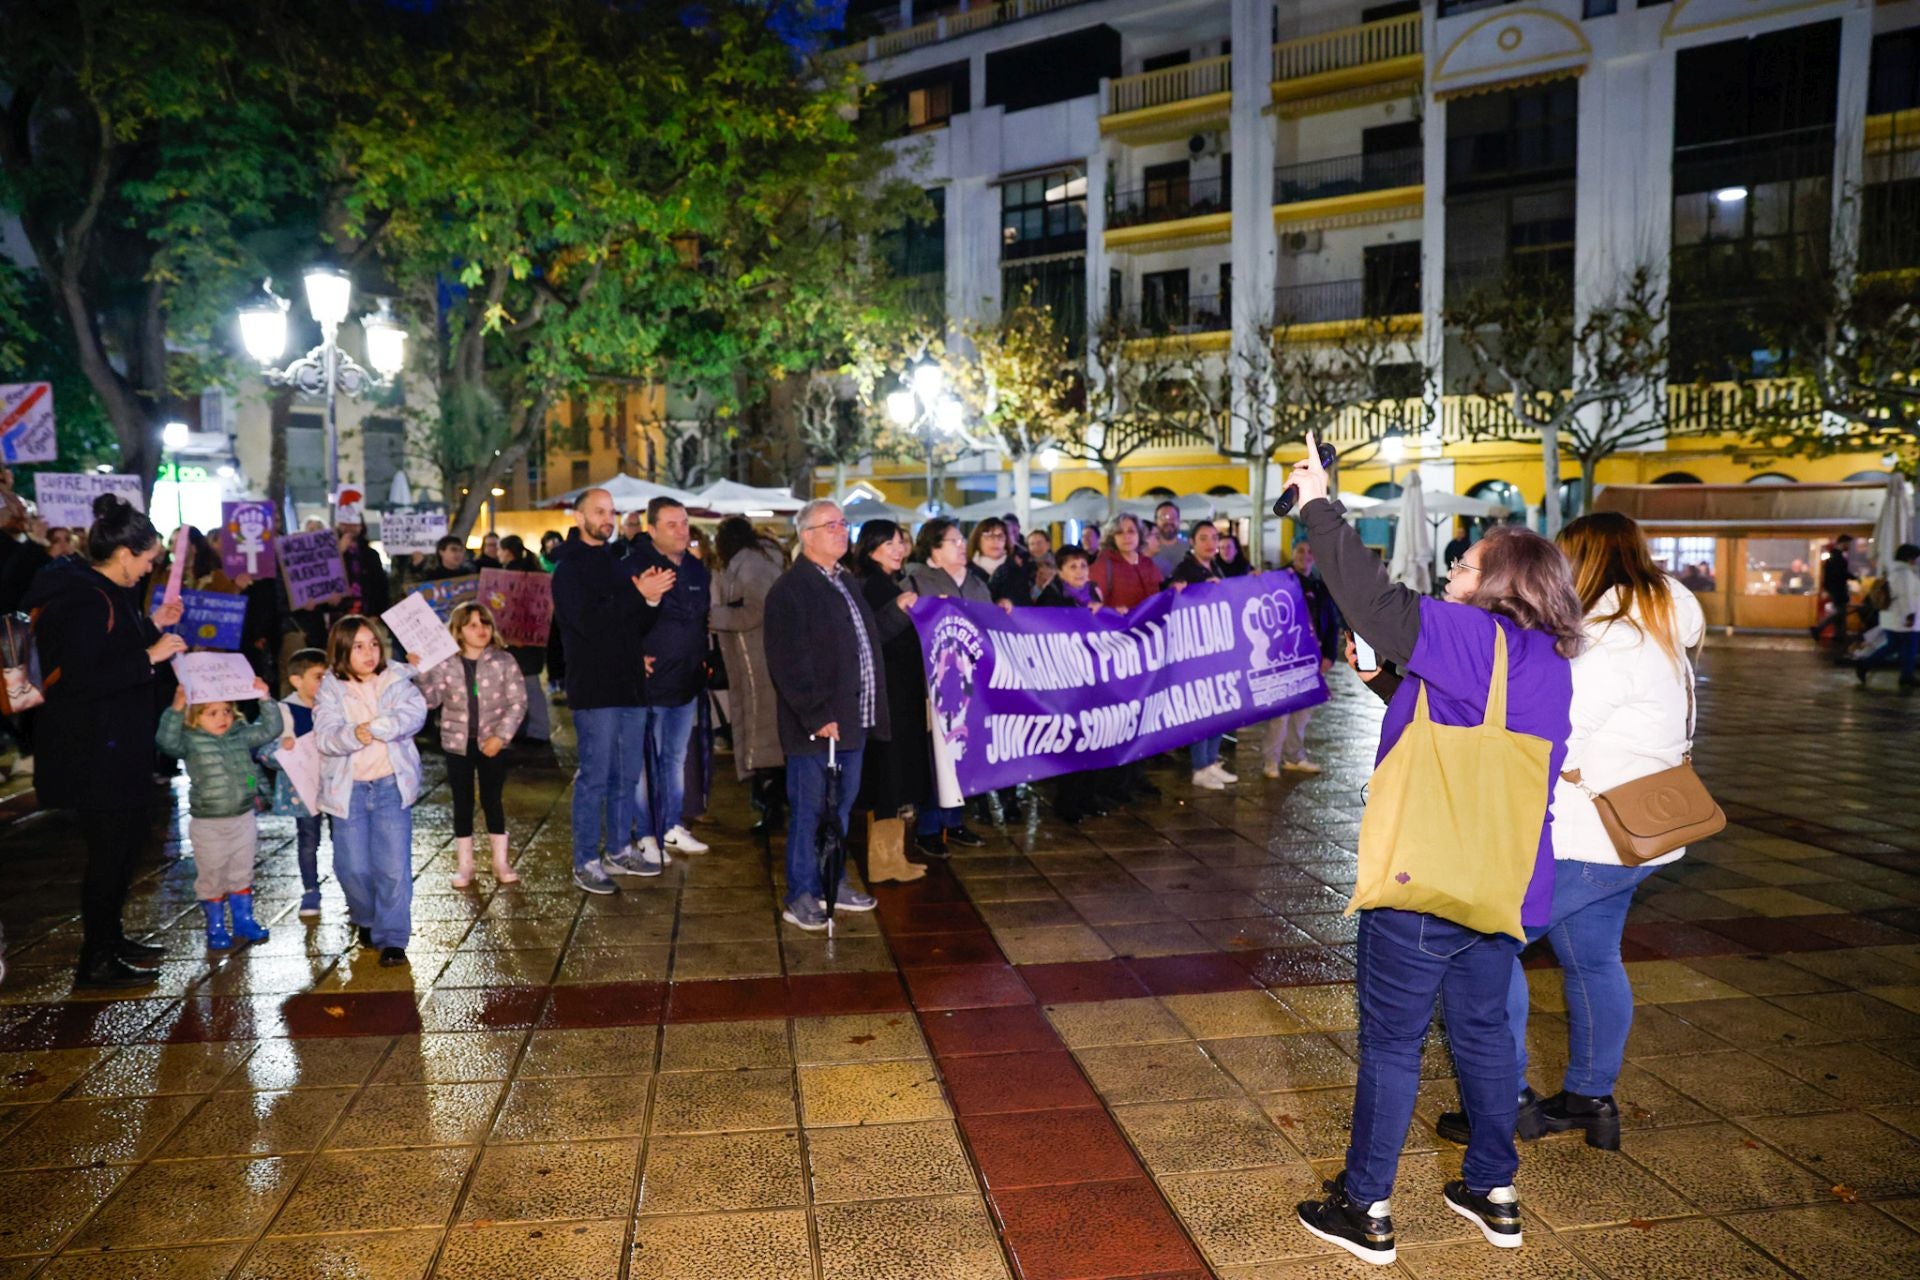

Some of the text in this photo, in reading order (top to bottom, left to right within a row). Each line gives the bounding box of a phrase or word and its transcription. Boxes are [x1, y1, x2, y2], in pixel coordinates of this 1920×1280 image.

[986, 629, 1096, 691] MARCHANDO
[1086, 630, 1143, 683] POR
[1130, 620, 1166, 672] LA
[1075, 699, 1141, 753] SOMOS
